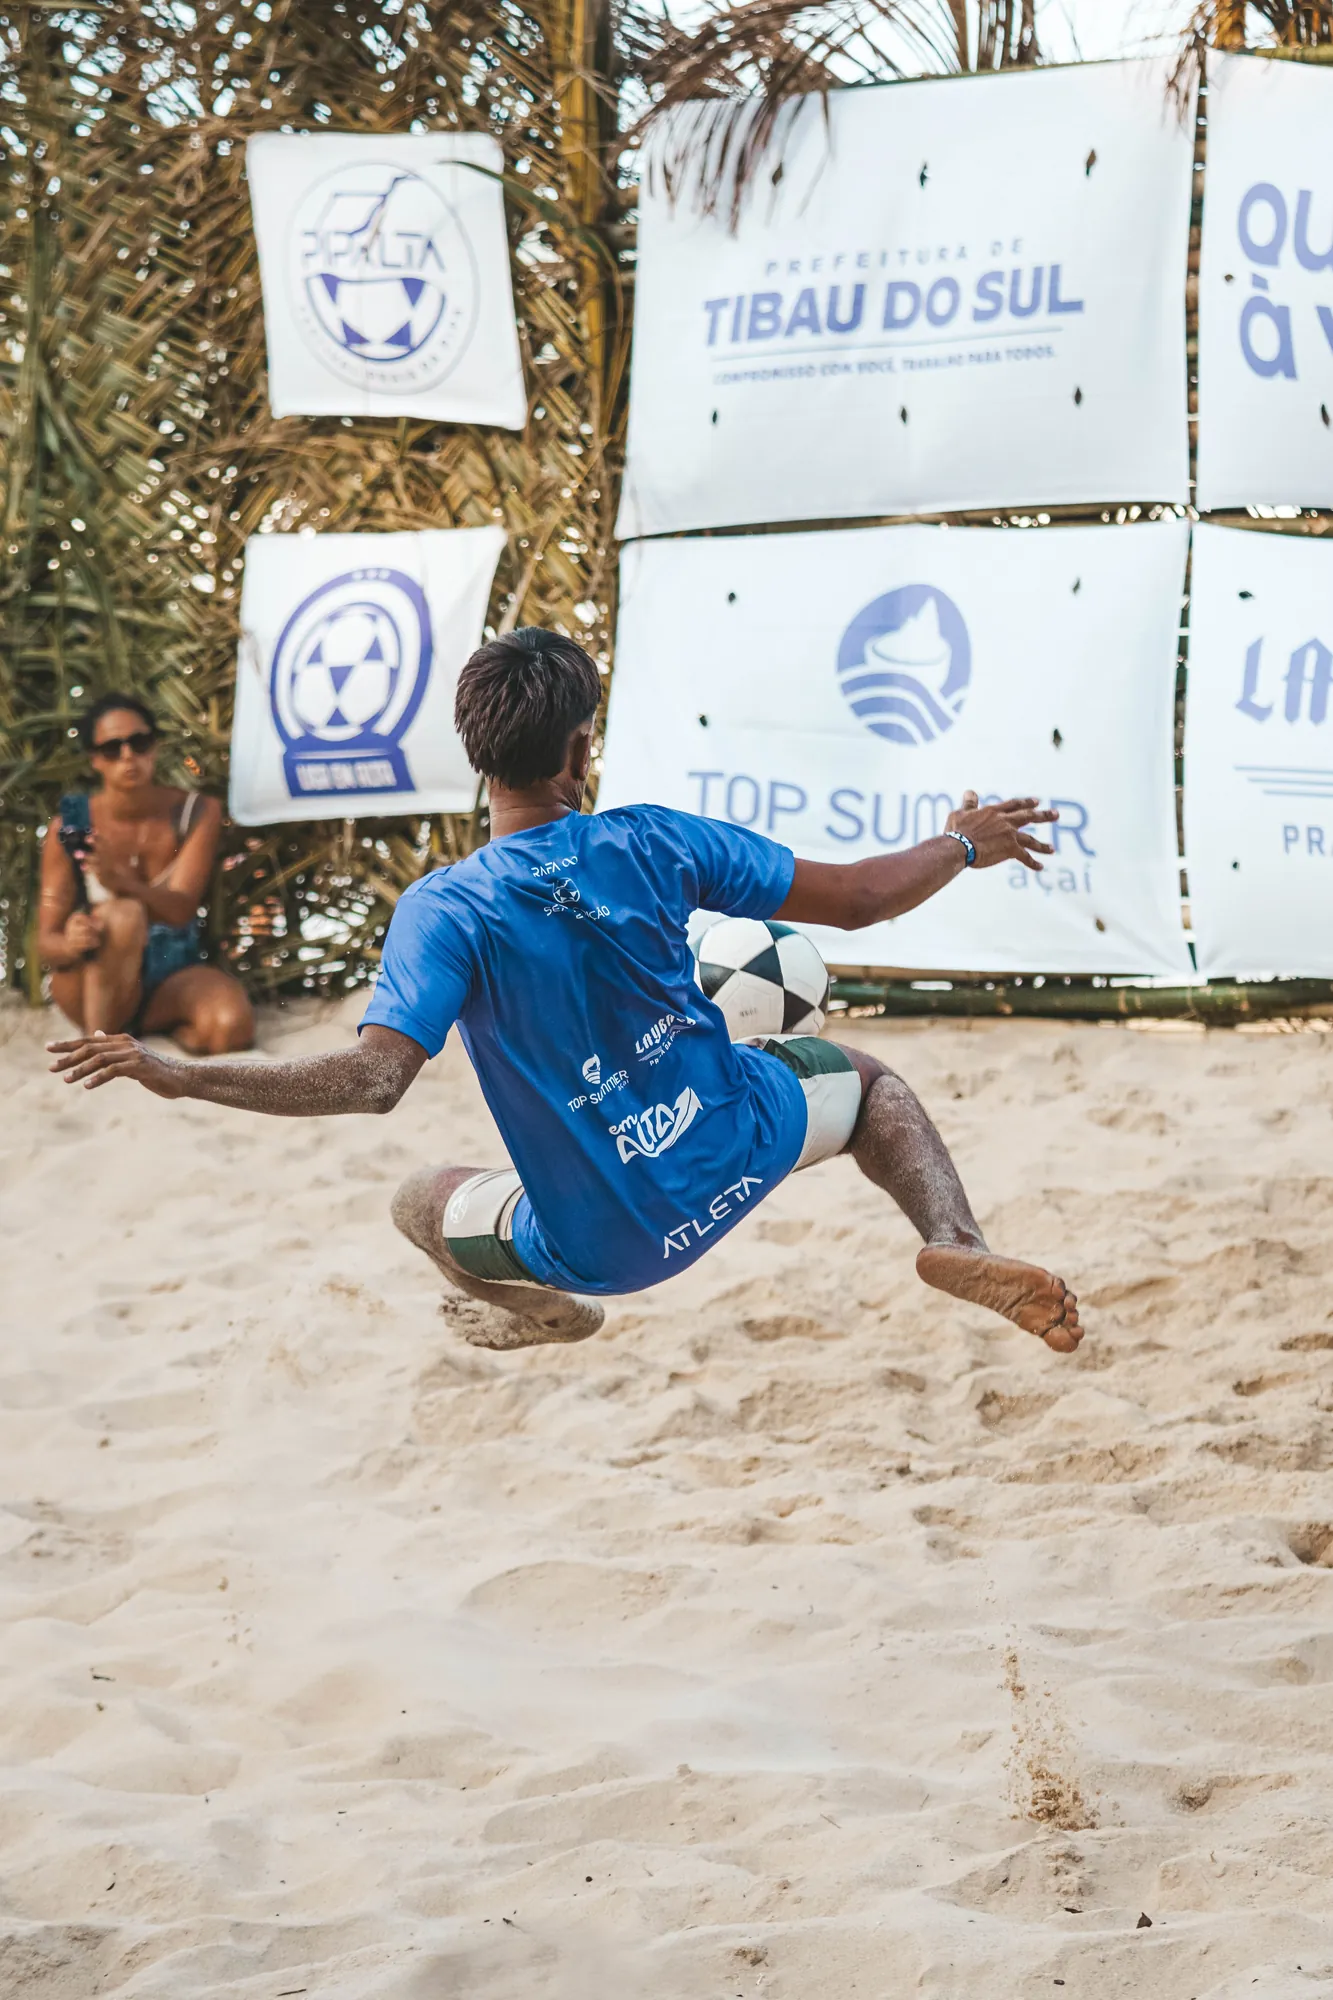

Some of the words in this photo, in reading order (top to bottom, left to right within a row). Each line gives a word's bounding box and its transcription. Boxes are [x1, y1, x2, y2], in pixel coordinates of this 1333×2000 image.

[766, 245, 967, 277] PREFEITURA
[990, 237, 1022, 257] DE
[704, 284, 866, 346] TIBAU
[882, 276, 960, 331] DO
[972, 264, 1084, 322] SUL
[687, 771, 807, 832] TOP
[824, 787, 1097, 858] SUMR
[1283, 824, 1333, 856] PR
[531, 861, 561, 877] RAFA
[567, 1095, 588, 1112] TOP
[589, 1069, 630, 1104] SUMMER
[608, 1113, 638, 1135] em
[616, 1103, 675, 1165] ALTA
[663, 1176, 764, 1259] ATLETA
